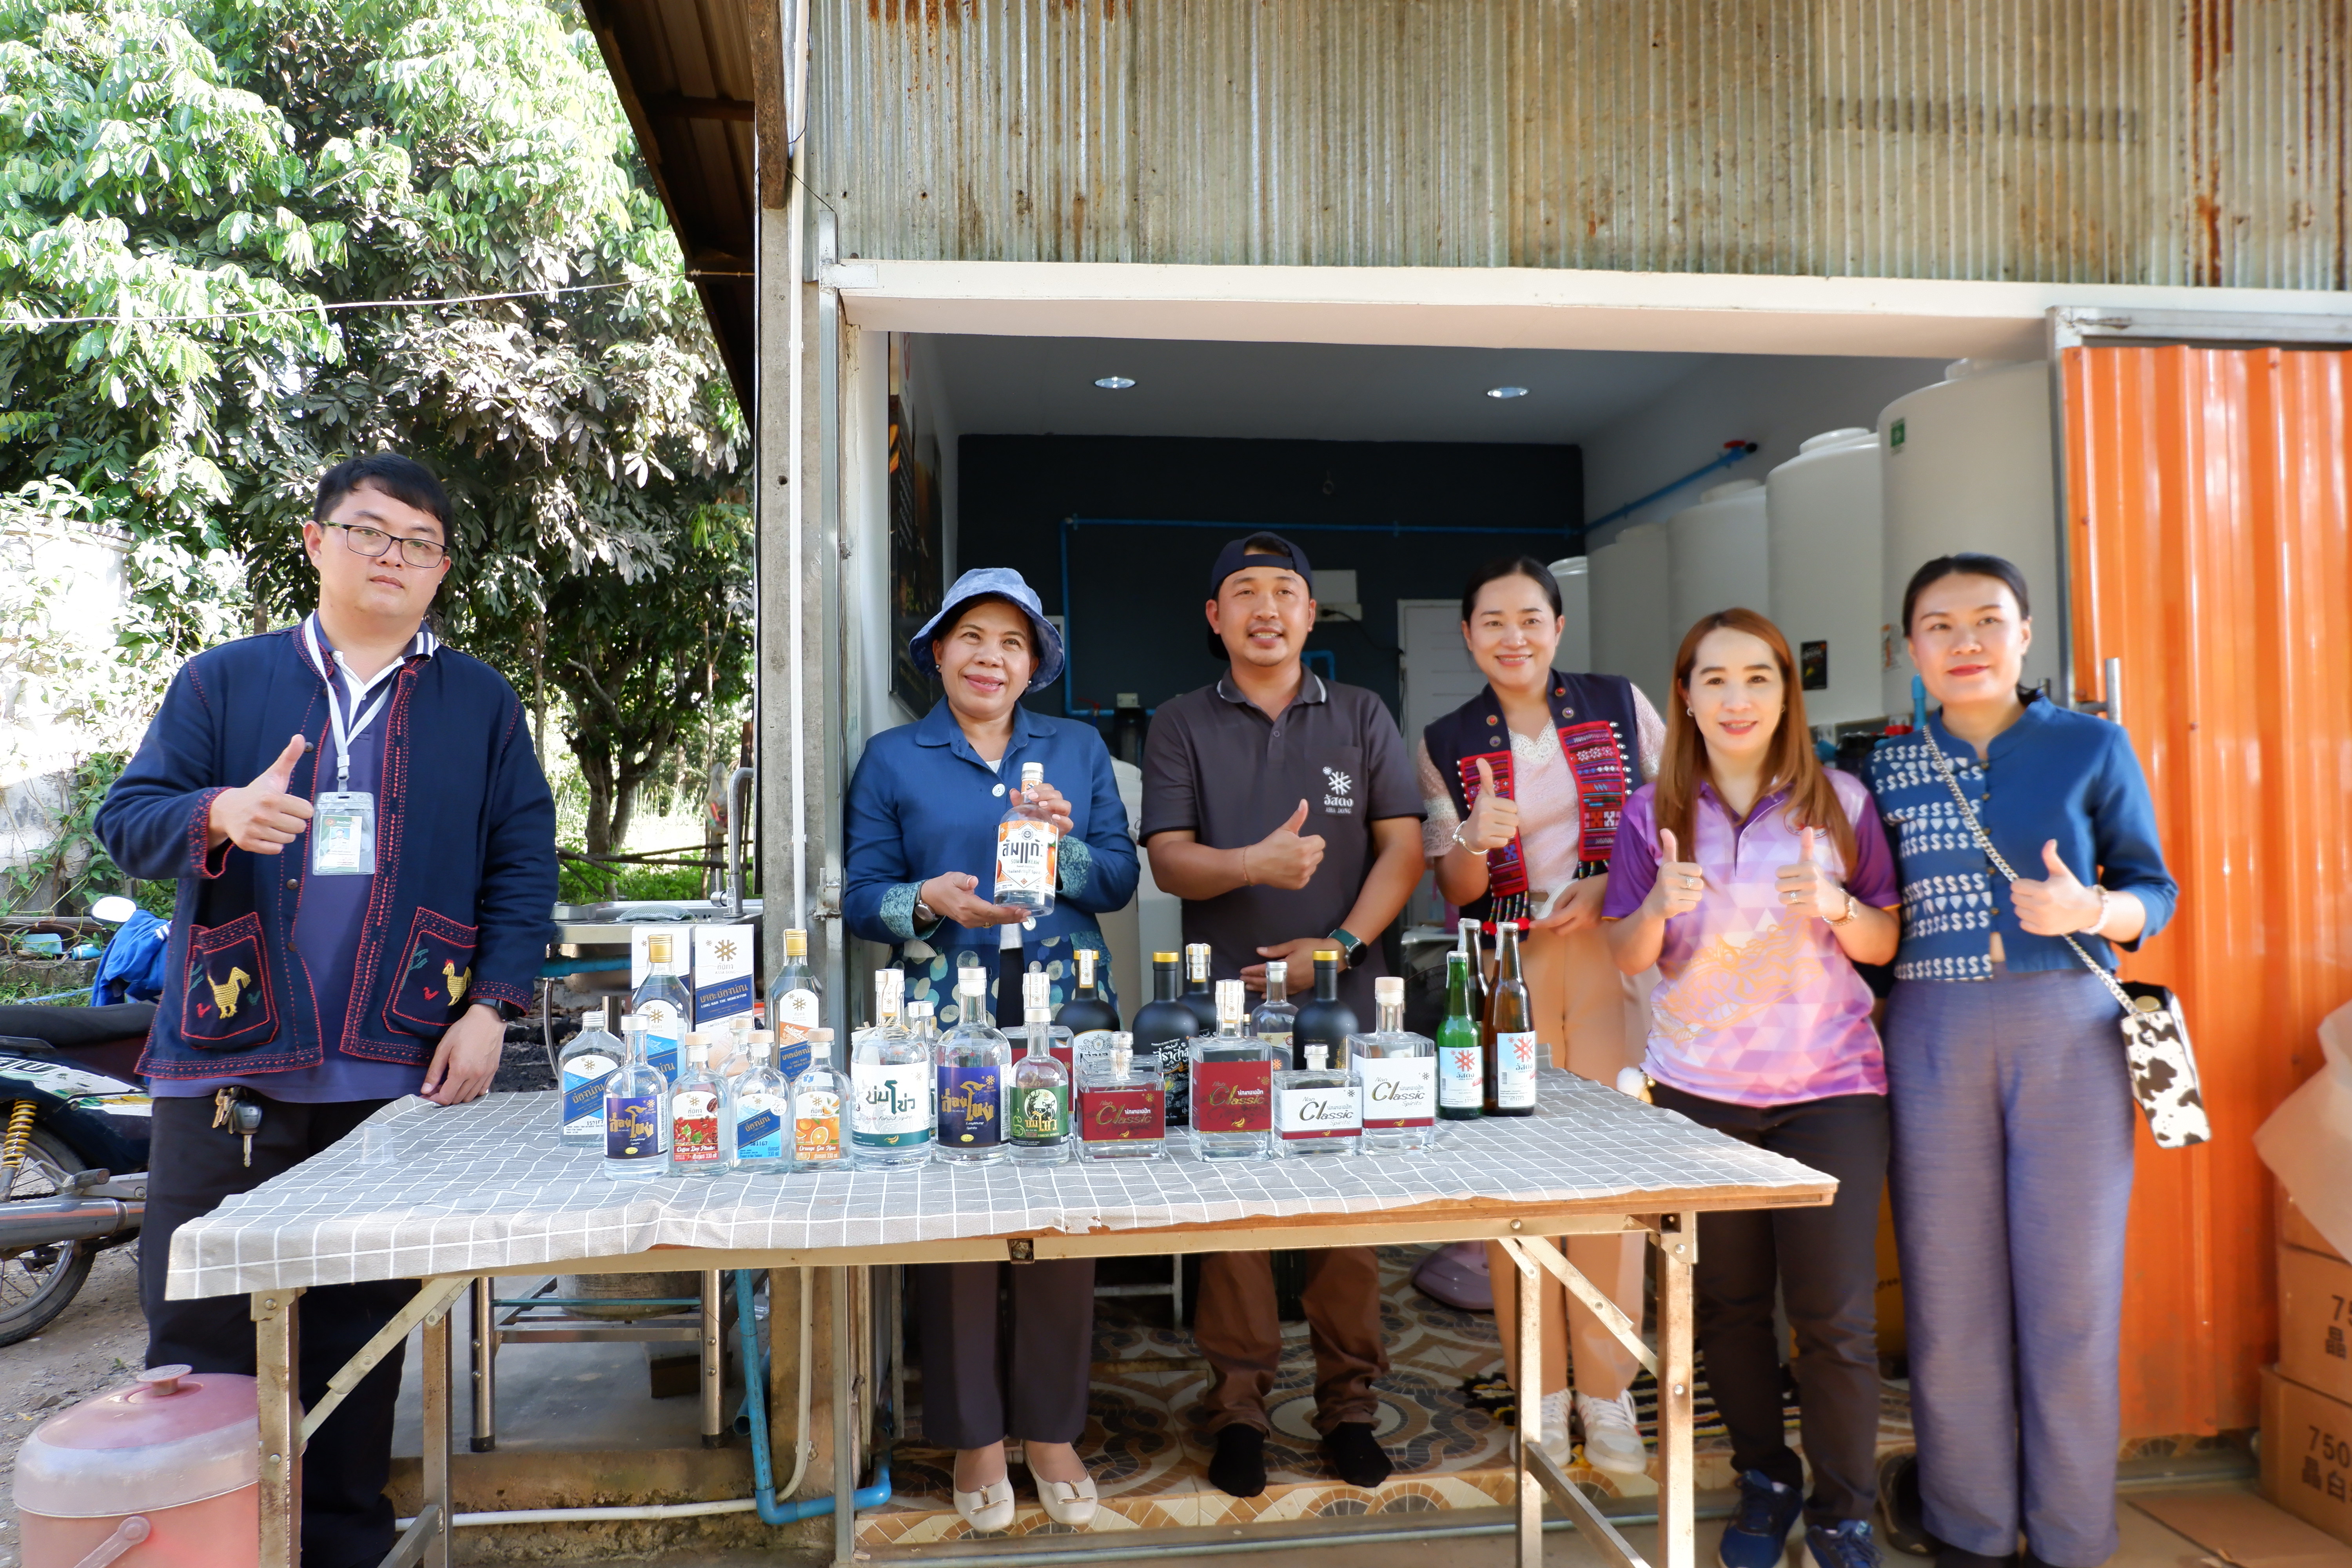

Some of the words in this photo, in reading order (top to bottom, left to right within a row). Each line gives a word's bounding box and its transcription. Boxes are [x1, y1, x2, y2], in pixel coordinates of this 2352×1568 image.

[1324, 794, 1354, 807] อัสดง
[727, 993, 747, 1002] MOMENTUM
[1209, 1085, 1265, 1105] Classic
[1372, 1081, 1425, 1101] Classic
[1096, 1104, 1152, 1125] Classic
[1299, 1100, 1354, 1121] Classic
[2309, 1425, 2350, 1468] 750
